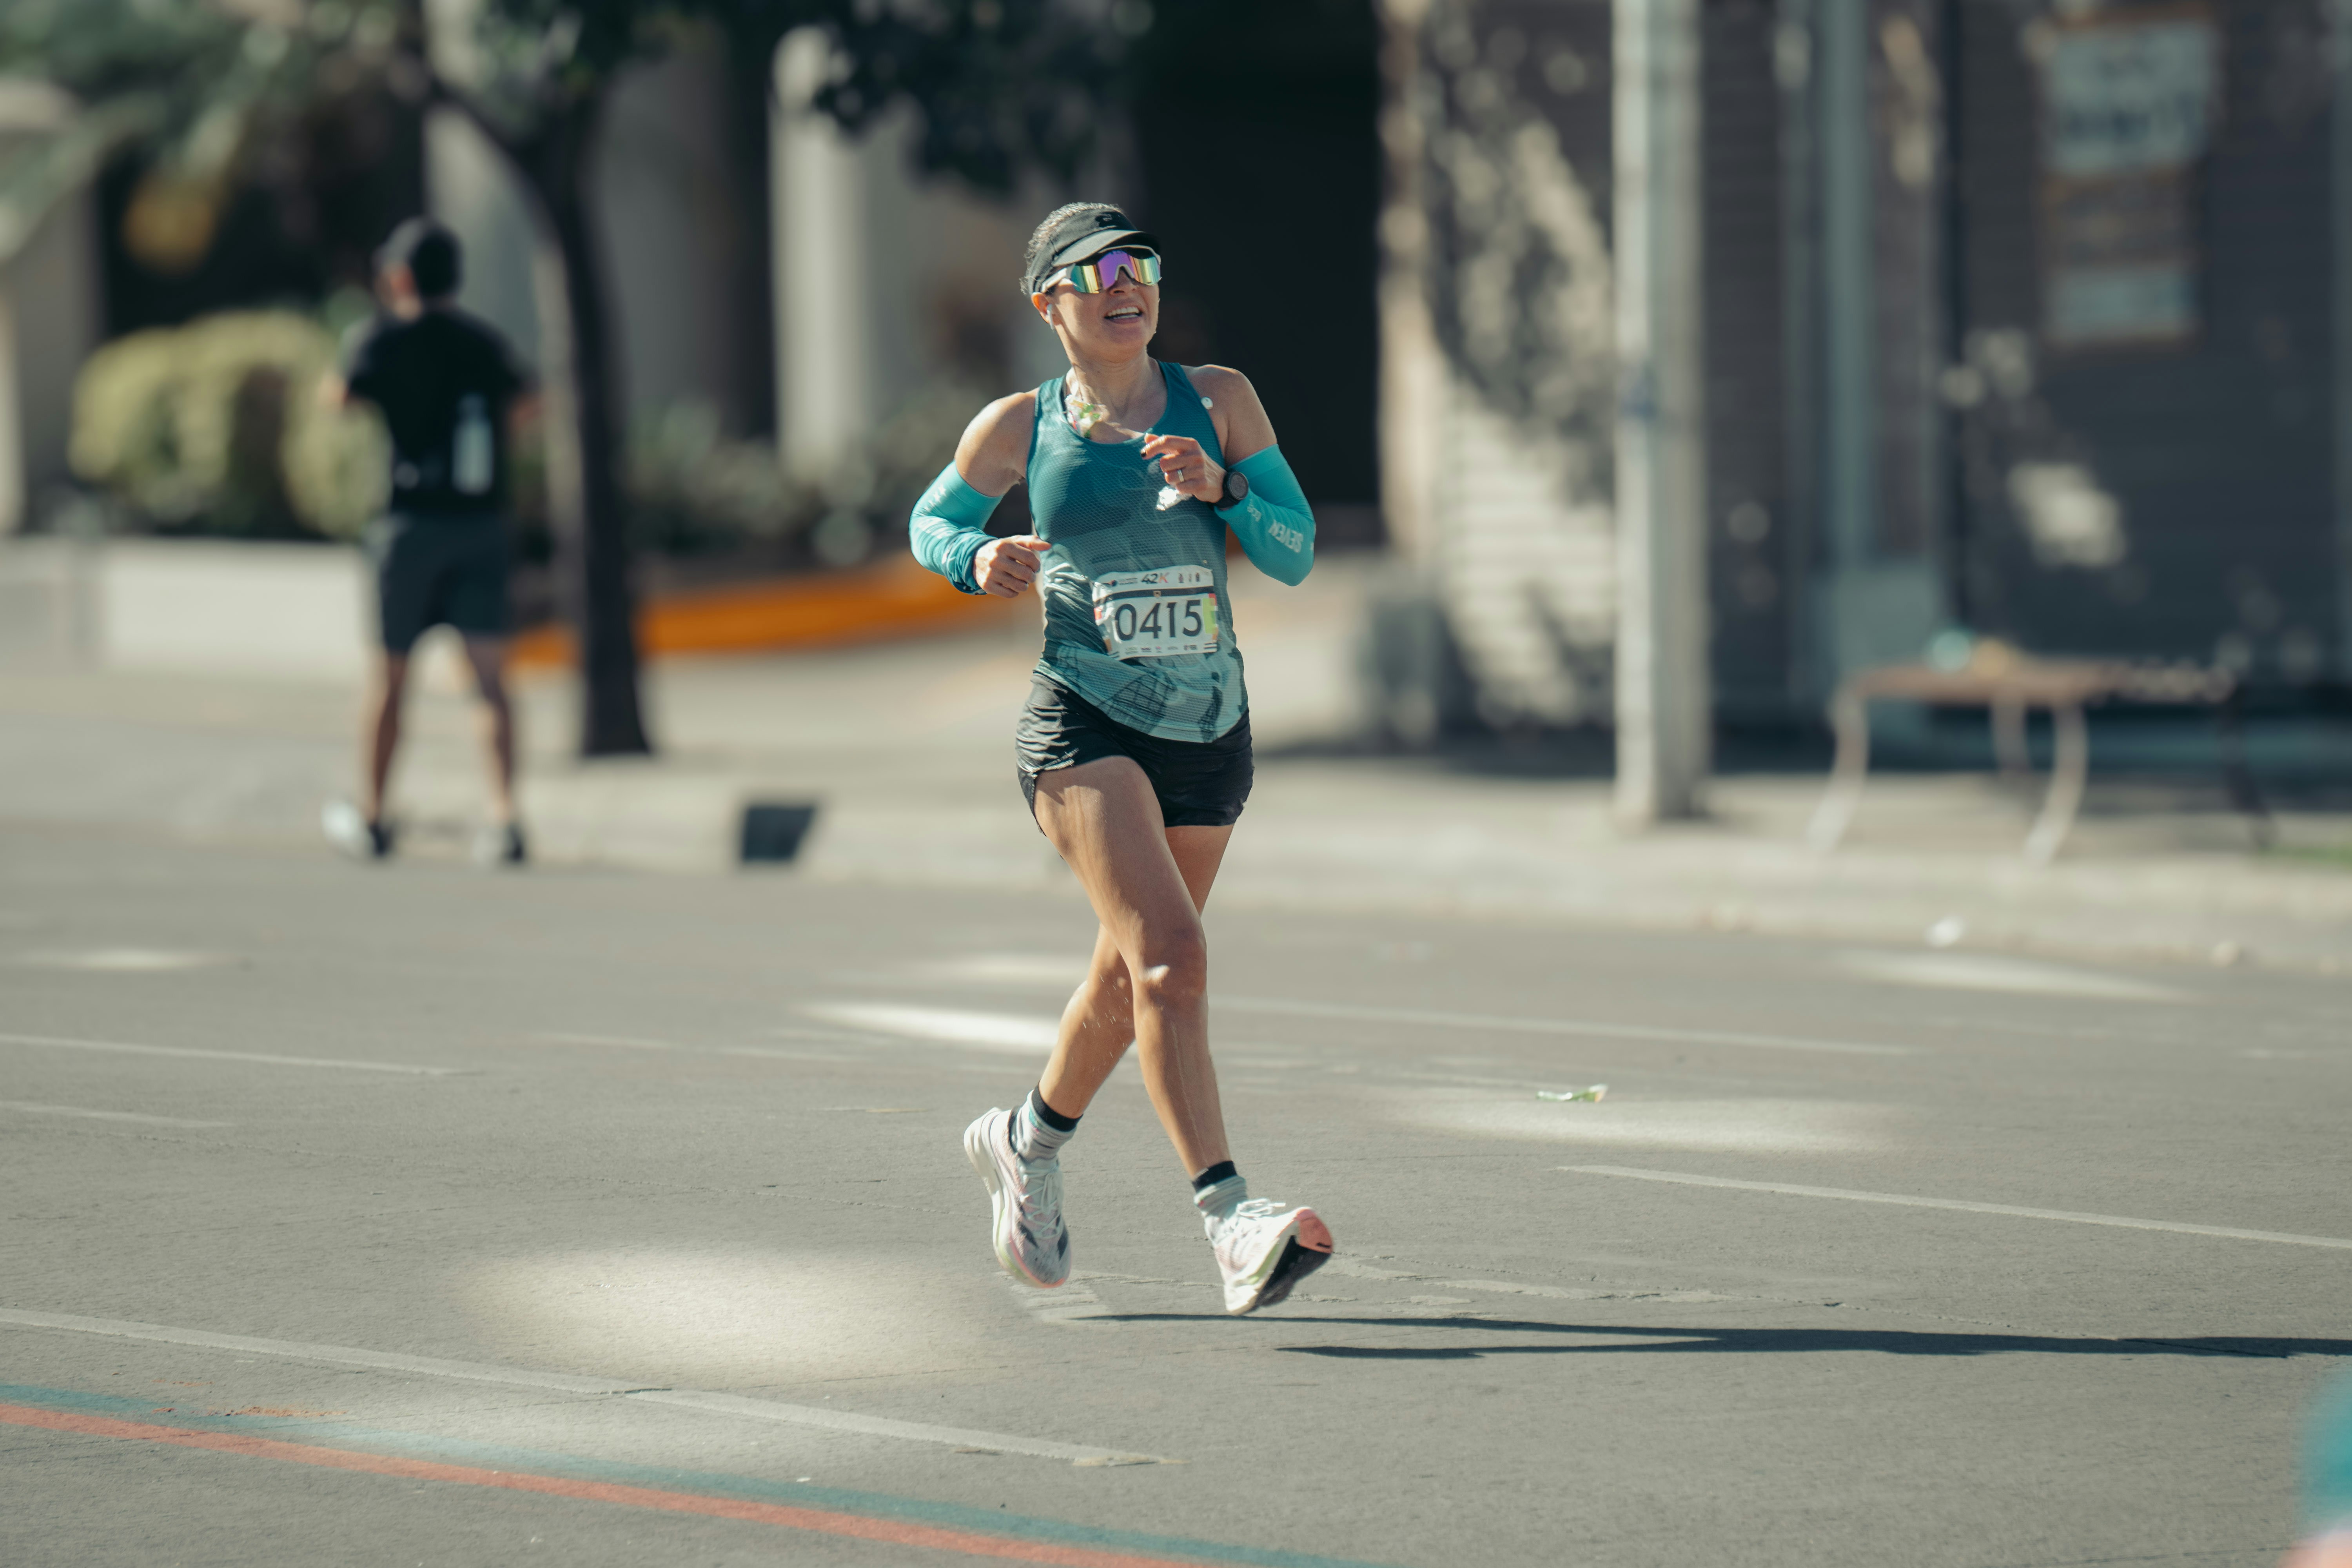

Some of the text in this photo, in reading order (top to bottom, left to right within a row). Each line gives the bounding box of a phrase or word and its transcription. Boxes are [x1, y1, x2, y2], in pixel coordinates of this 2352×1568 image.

[1268, 519, 1304, 553] SEVEN
[1141, 572, 1170, 584] 42K
[1115, 599, 1201, 641] 0415
